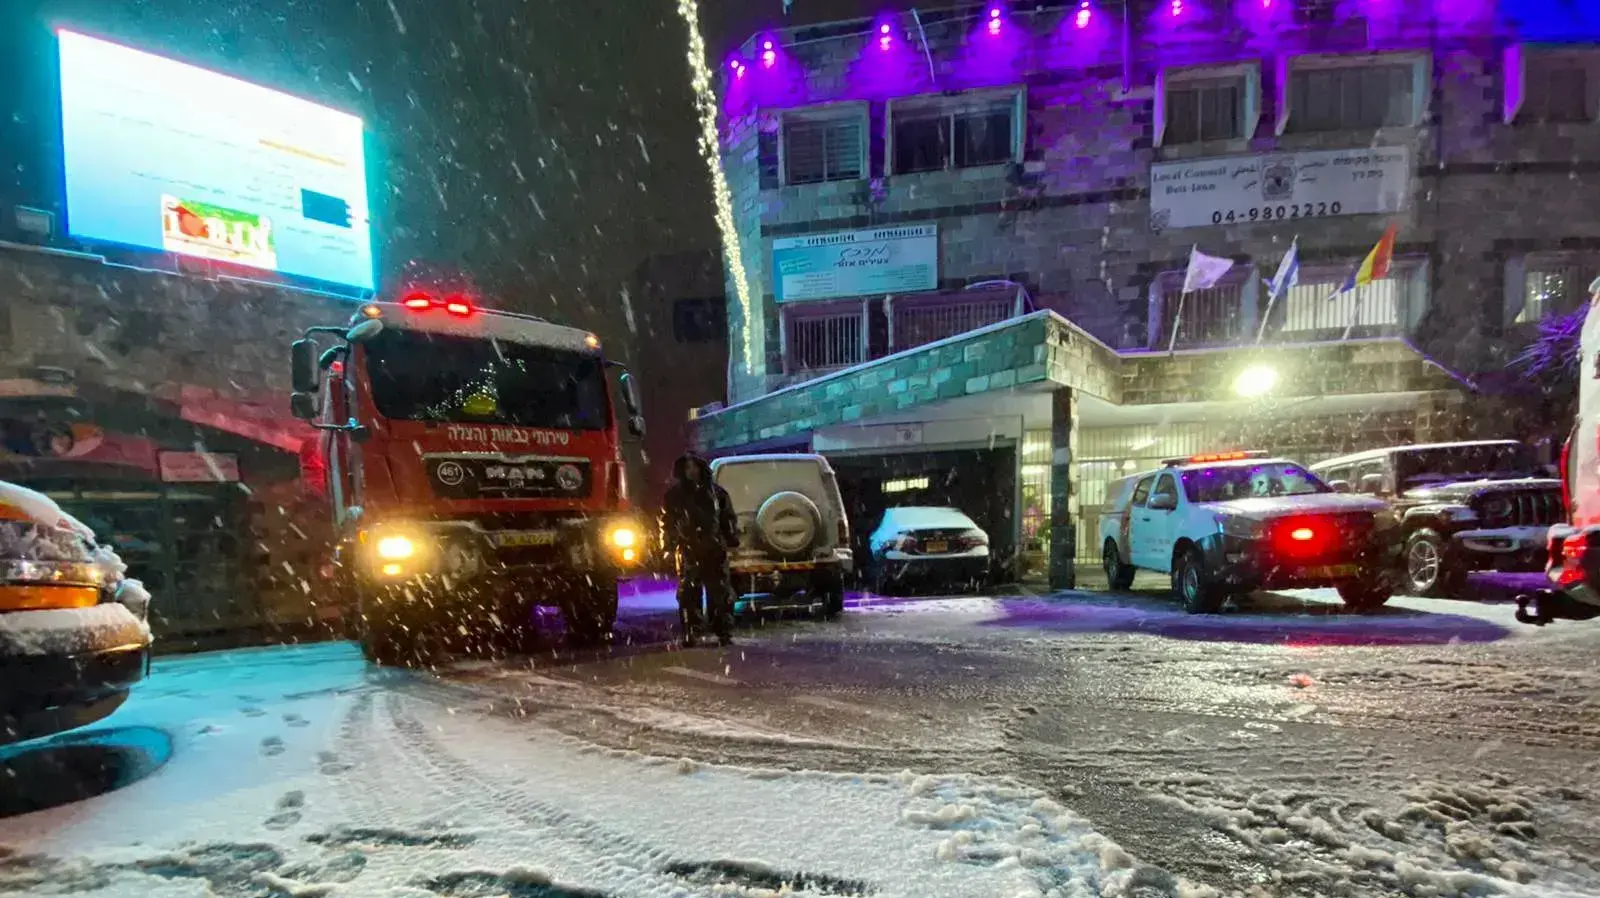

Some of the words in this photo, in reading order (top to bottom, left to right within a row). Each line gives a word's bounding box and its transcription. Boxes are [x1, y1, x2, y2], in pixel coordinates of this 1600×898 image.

[1211, 201, 1342, 225] 04-9802220
[447, 425, 488, 443] והצלה
[490, 426, 529, 444] כבאות
[532, 430, 569, 445] שירותי
[440, 466, 460, 477] 461
